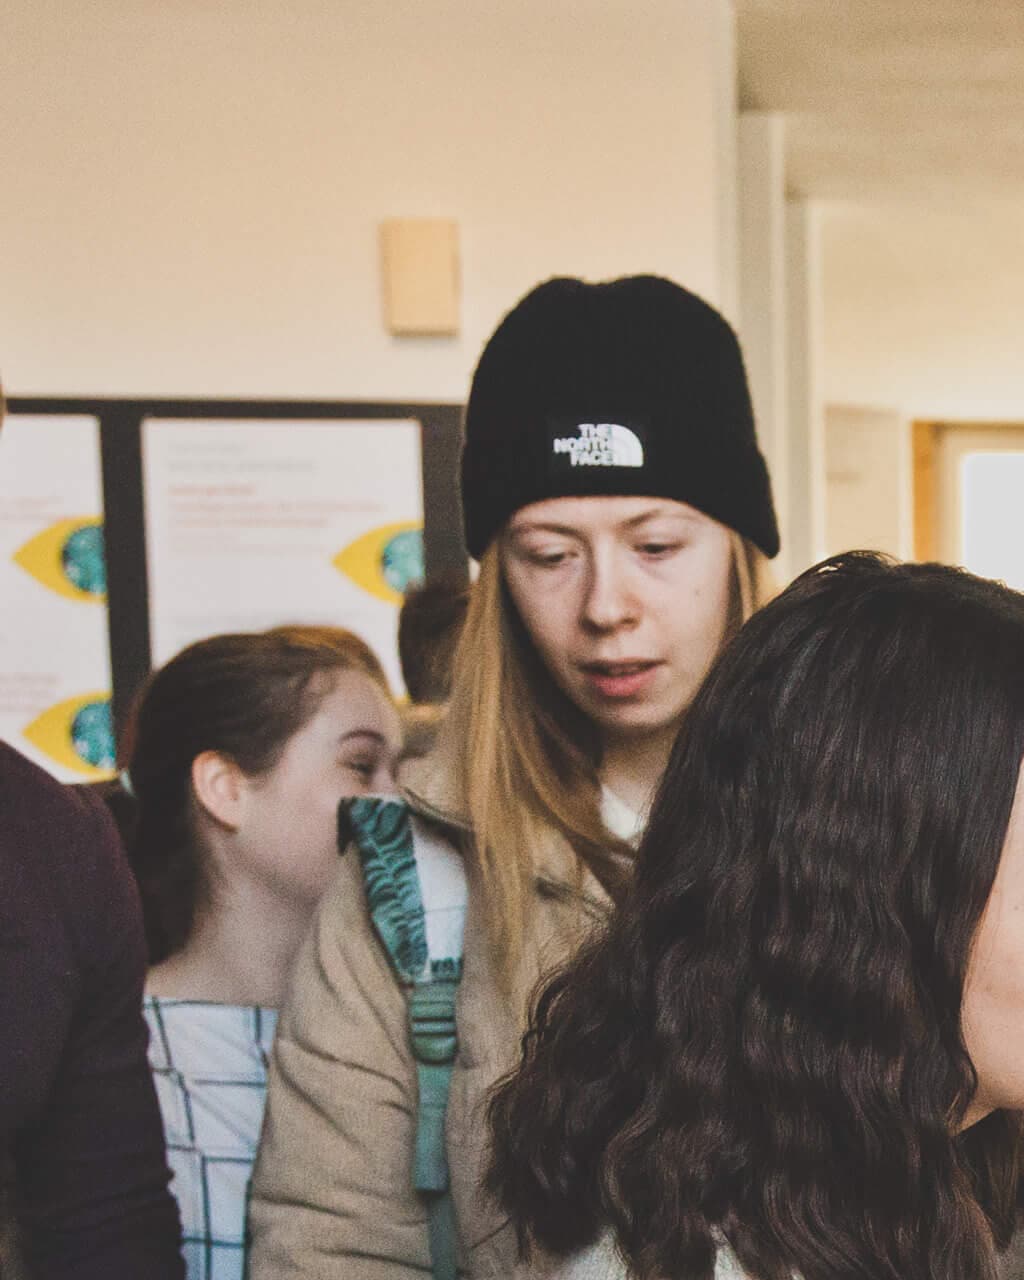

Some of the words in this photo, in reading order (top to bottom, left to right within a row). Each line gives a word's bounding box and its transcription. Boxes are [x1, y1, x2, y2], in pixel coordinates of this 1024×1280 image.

[578, 423, 610, 438] THE
[553, 438, 611, 453] NORTH
[571, 452, 612, 466] FACE
